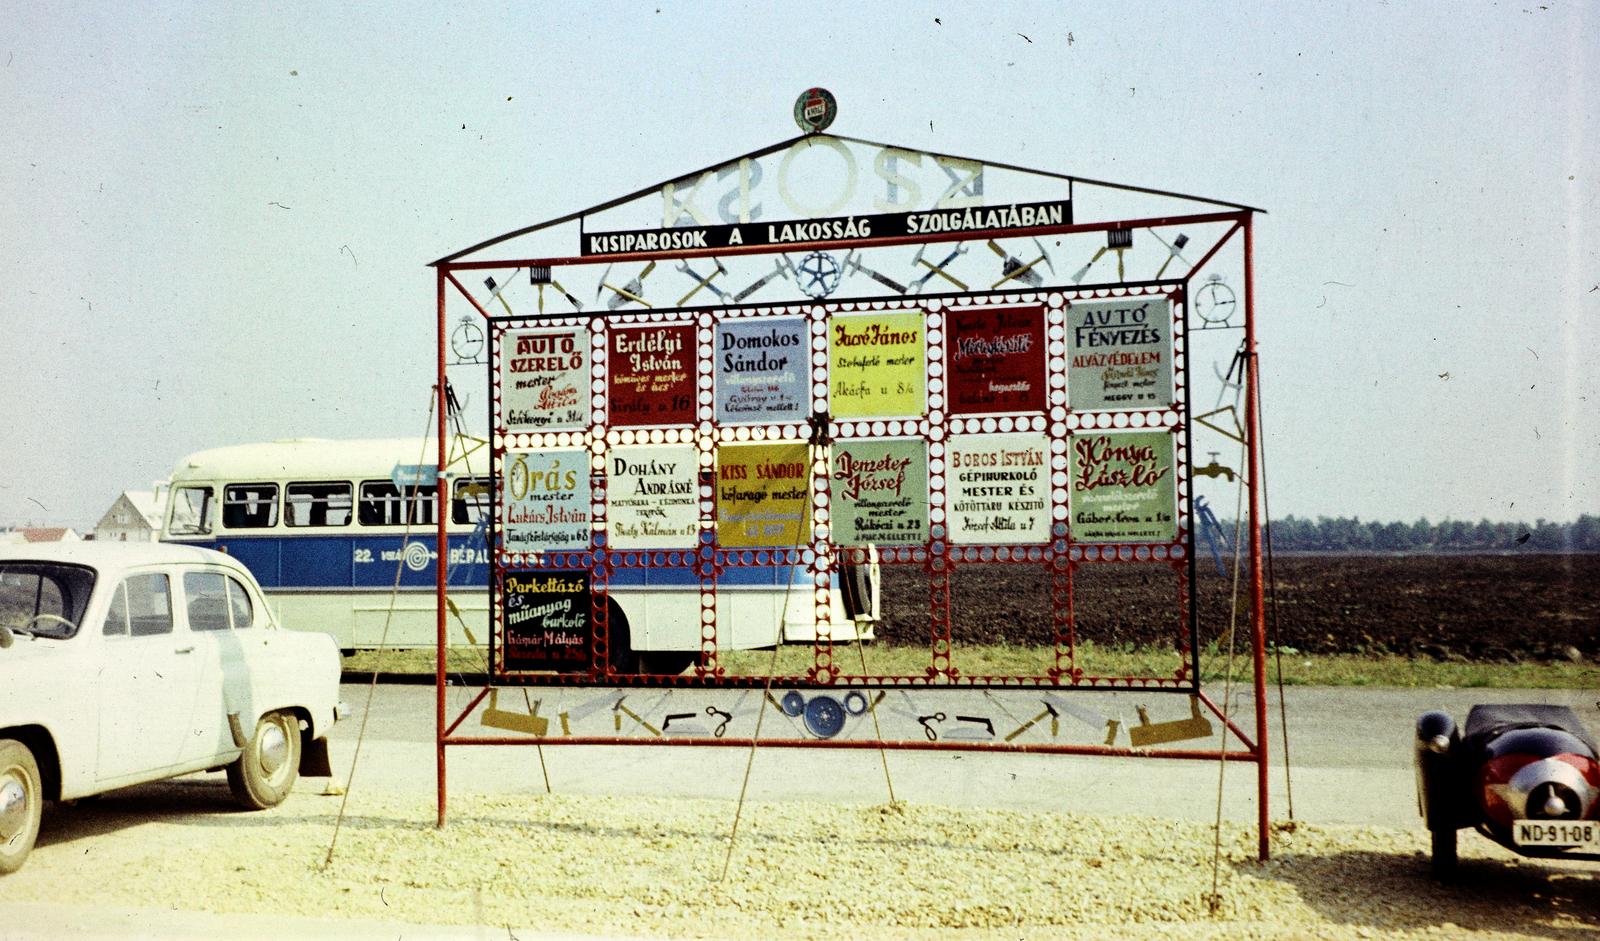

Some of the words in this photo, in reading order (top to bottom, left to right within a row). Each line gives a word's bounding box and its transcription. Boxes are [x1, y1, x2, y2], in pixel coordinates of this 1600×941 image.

[590, 230, 708, 254] KISIPAROSOK
[729, 227, 744, 245] A
[768, 215, 872, 243] LAKOSSÁG
[906, 203, 1063, 234] SZOLGÁLATÁBAN
[1083, 303, 1149, 326] AUTÓ
[615, 329, 683, 355] Erdélyi
[721, 328, 800, 351] Domokos
[871, 324, 918, 346] János
[1075, 323, 1161, 348] FÉNYEZÉS
[509, 351, 583, 373] SZERELŐ
[629, 353, 683, 372] István
[723, 351, 788, 373] Sándor
[515, 372, 566, 390] mester
[952, 451, 997, 468] BOROS
[1000, 447, 1044, 467] ISTVÁN
[1074, 435, 1158, 467] Kónya
[614, 458, 677, 476] DOHÁNY
[720, 463, 748, 481] KISS
[756, 458, 805, 480] SÁNDOR
[834, 450, 912, 481] Demeter
[1074, 461, 1170, 492] László
[510, 453, 577, 501] Órás
[633, 477, 693, 496] ANDRÁSNÉ
[841, 471, 905, 501] József
[530, 491, 574, 501] mester
[772, 486, 808, 500] mester
[962, 486, 1013, 497] MESTER
[1019, 483, 1035, 496] ÉS
[545, 504, 586, 525] István
[869, 509, 906, 517] mester
[505, 577, 584, 593] Parkettázó
[508, 594, 524, 608] és
[508, 598, 572, 625] műanyag
[543, 630, 584, 648] Mátyás
[1521, 825, 1593, 842] ND-91-08
